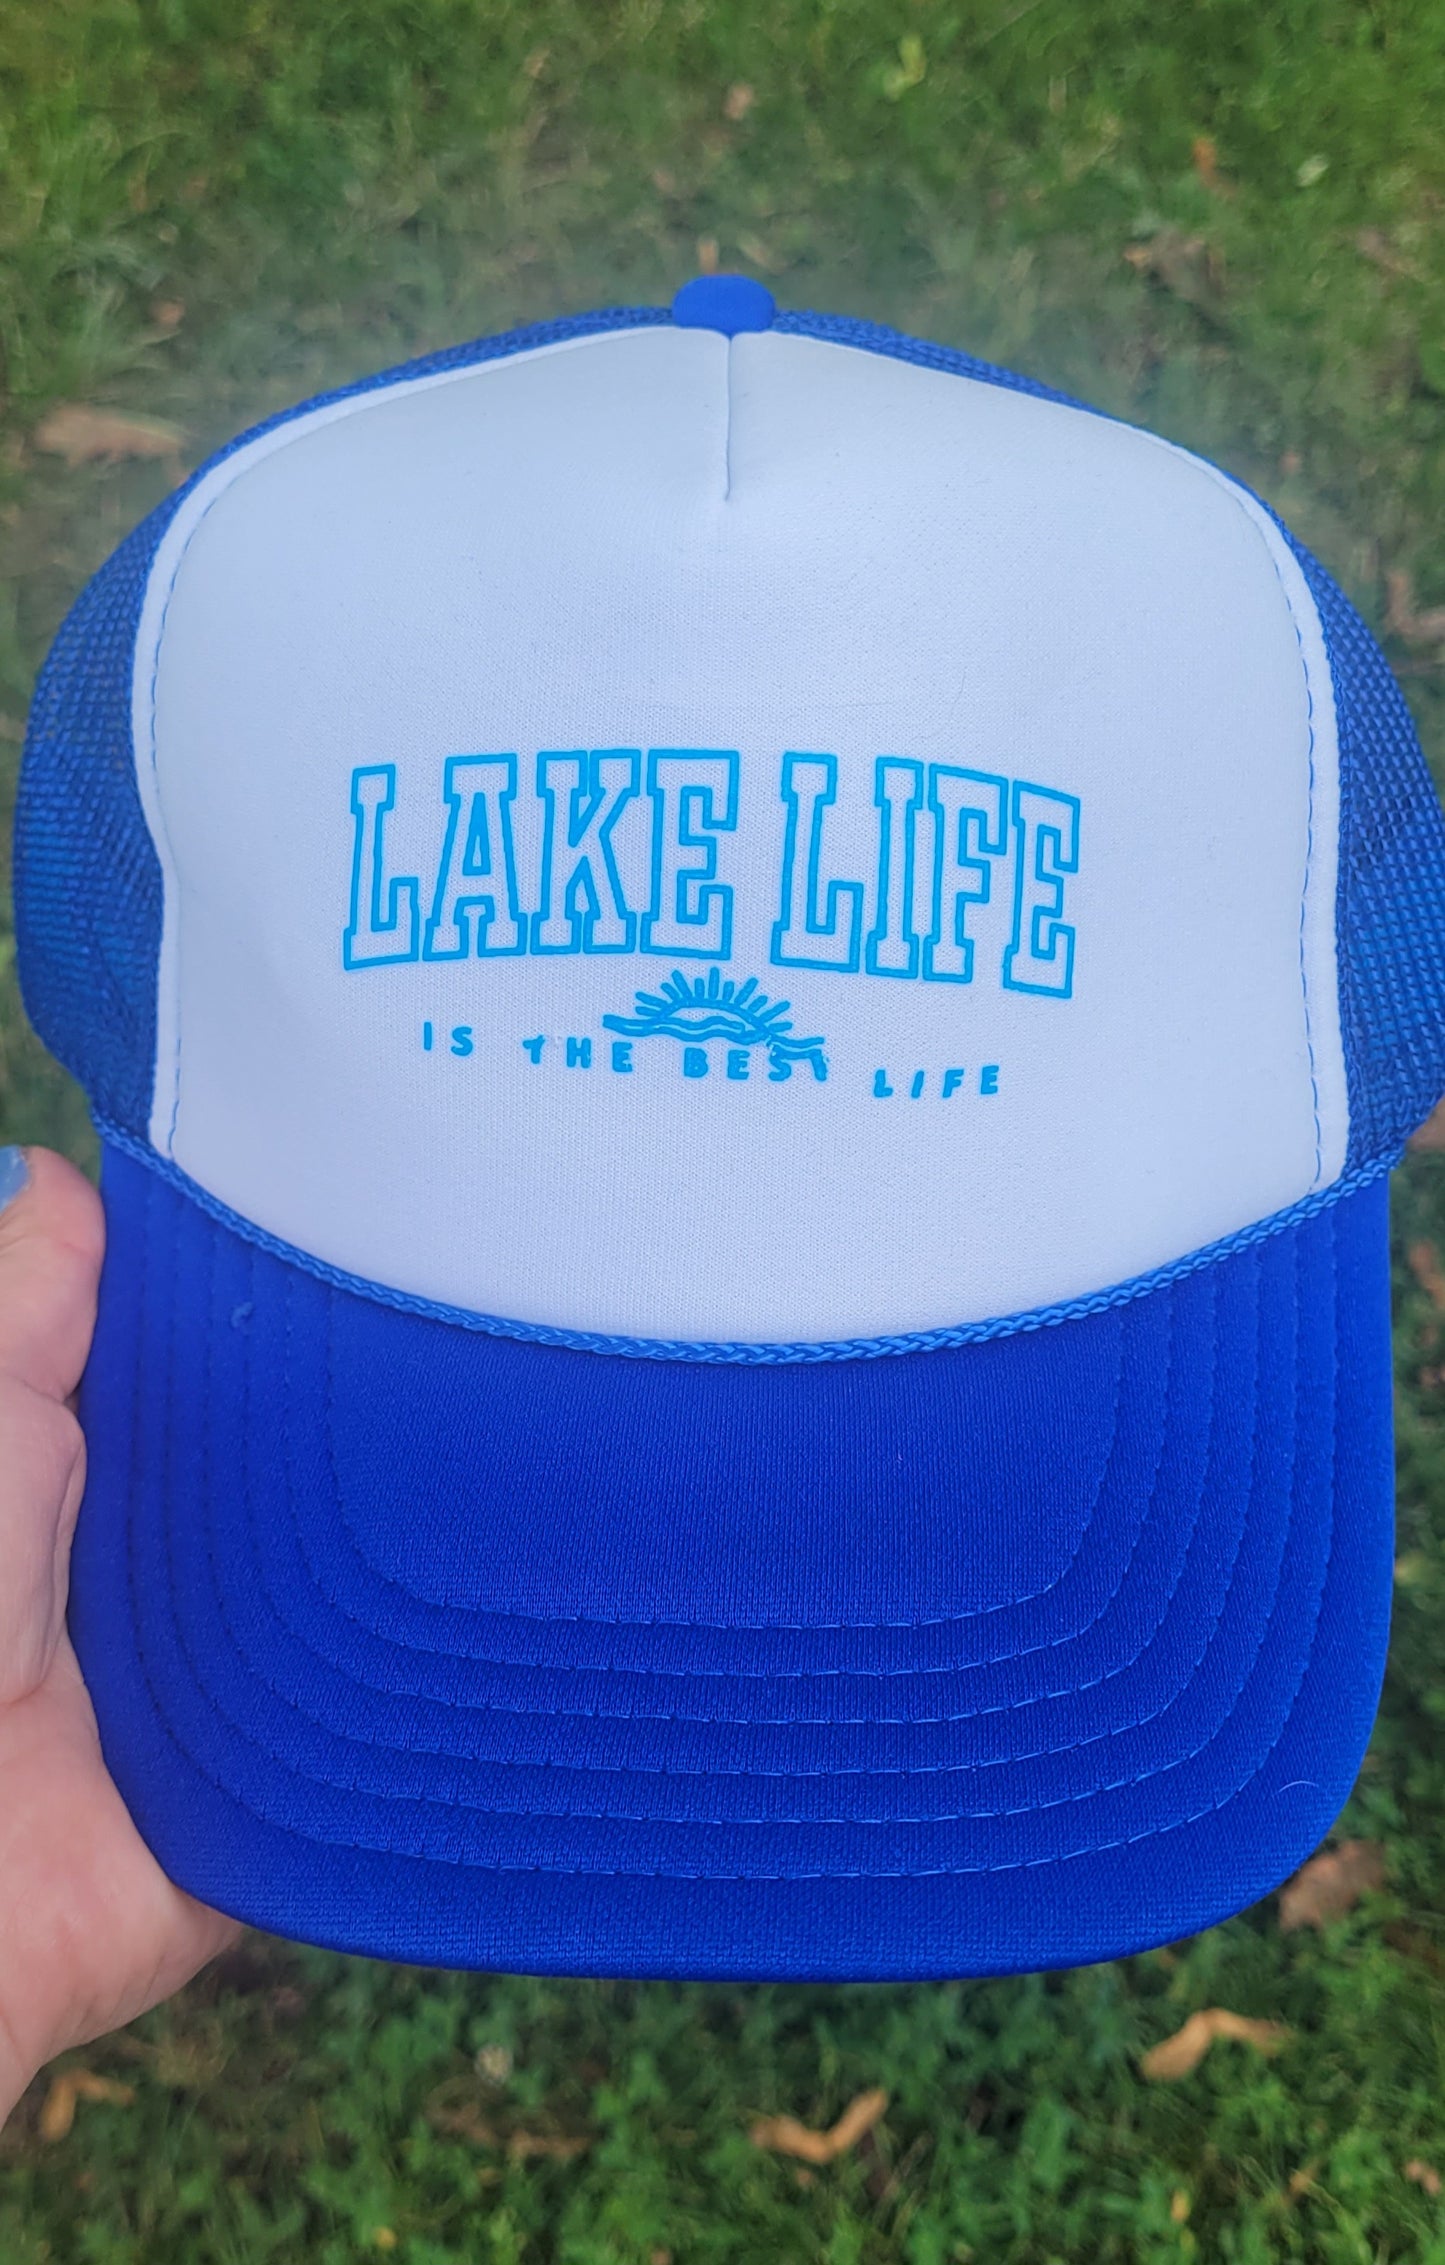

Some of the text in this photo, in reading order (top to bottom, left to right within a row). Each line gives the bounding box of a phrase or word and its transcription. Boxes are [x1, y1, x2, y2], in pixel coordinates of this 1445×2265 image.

[343, 748, 1081, 1000] LAKE LIFE
[422, 1020, 475, 1058] IS
[521, 1034, 635, 1074] THE
[872, 1065, 1000, 1100] LIFE
